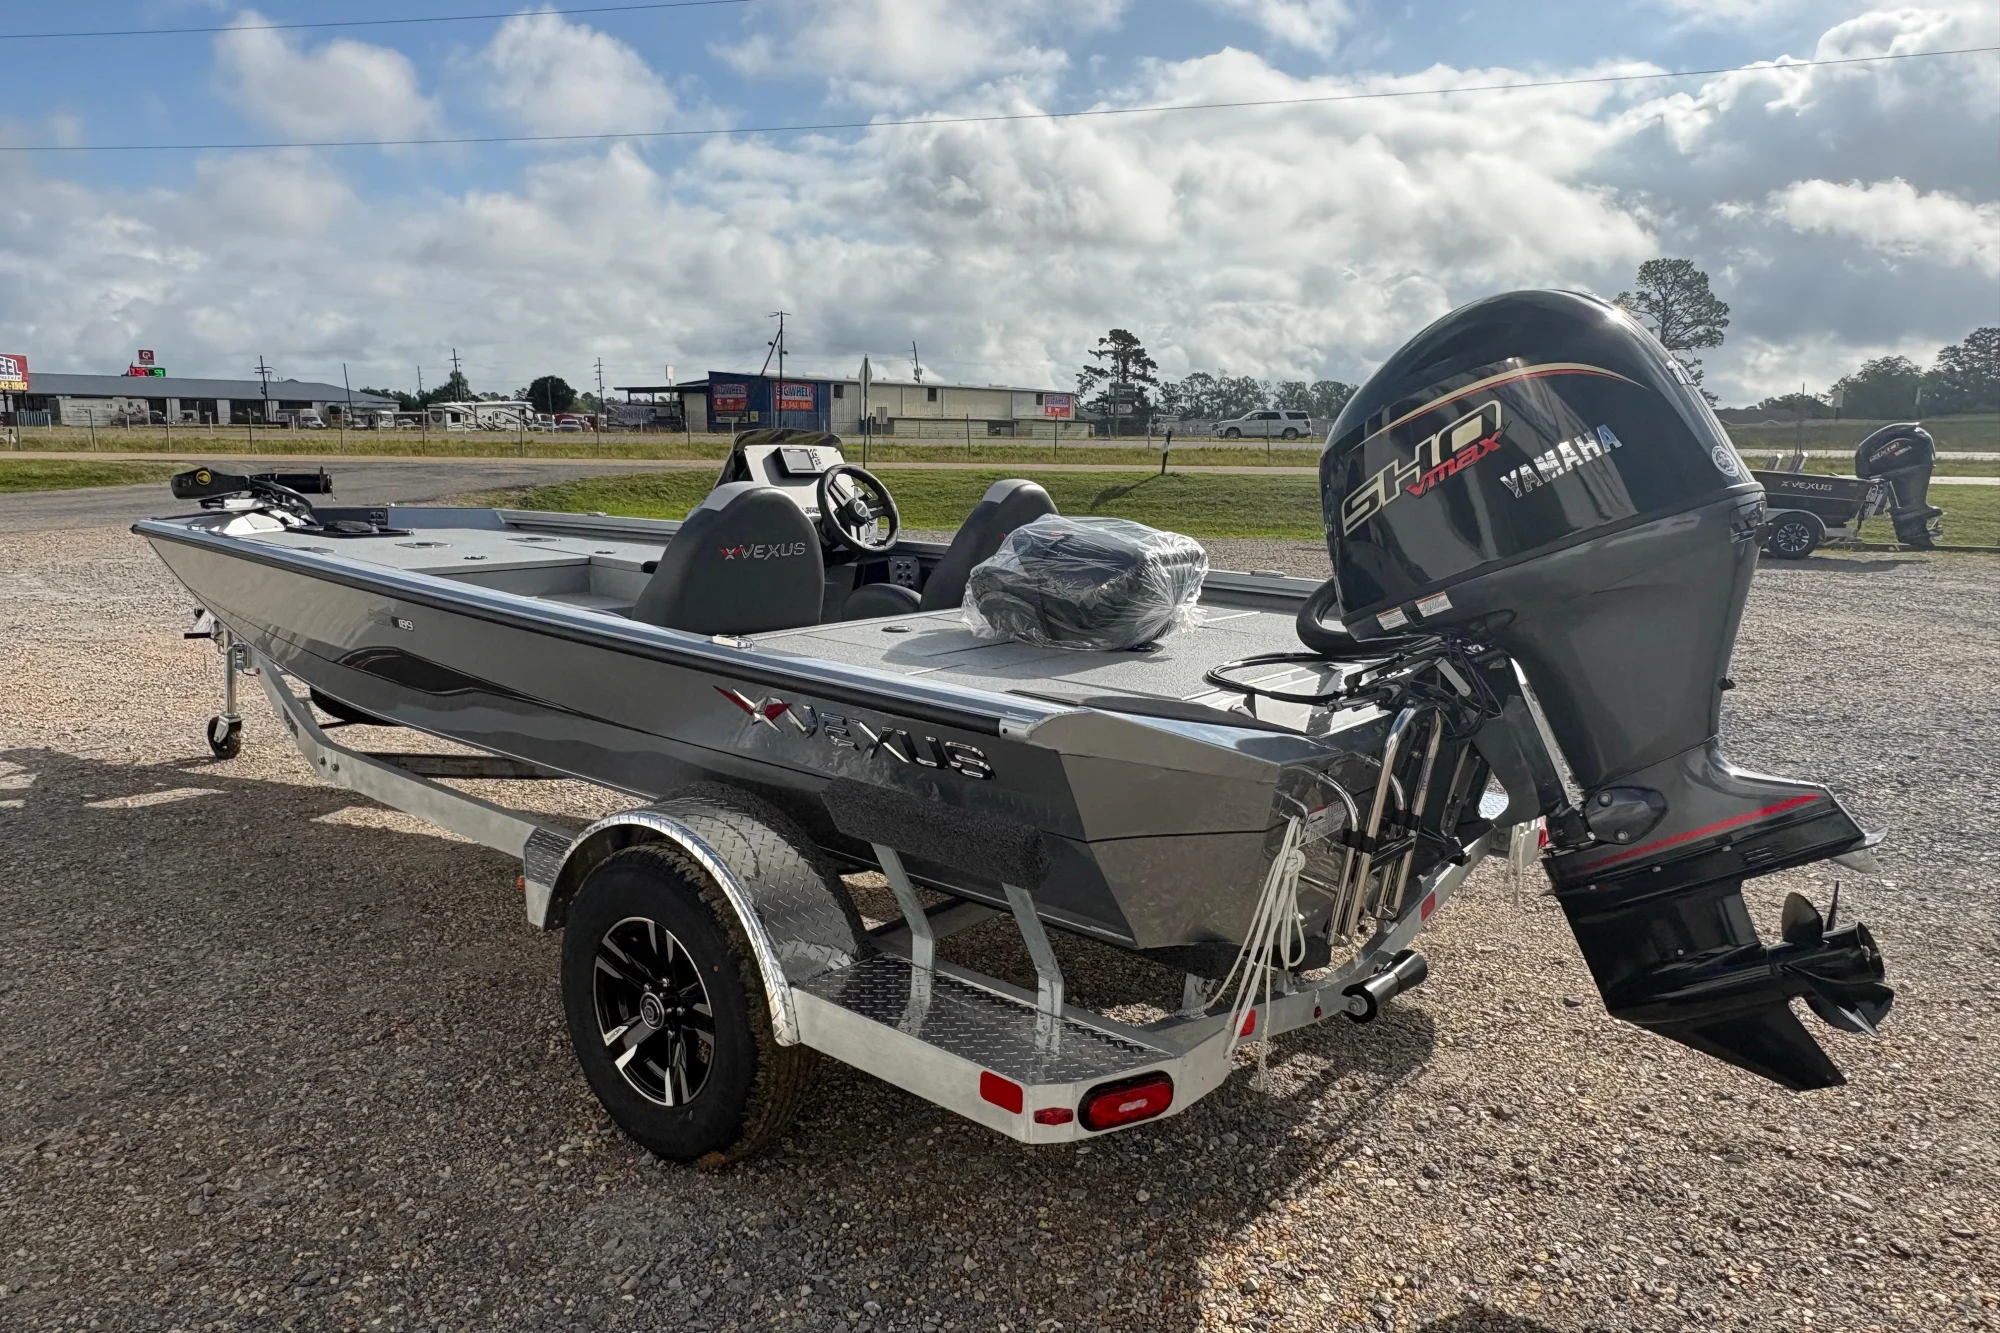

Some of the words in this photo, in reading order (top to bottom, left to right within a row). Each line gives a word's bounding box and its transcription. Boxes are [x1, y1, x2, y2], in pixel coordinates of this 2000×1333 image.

[775, 384, 814, 397] BGWHEEL
[1500, 424, 1622, 498] YAMAHA
[739, 542, 806, 560] VEXUS
[771, 696, 996, 780] VEXUS
